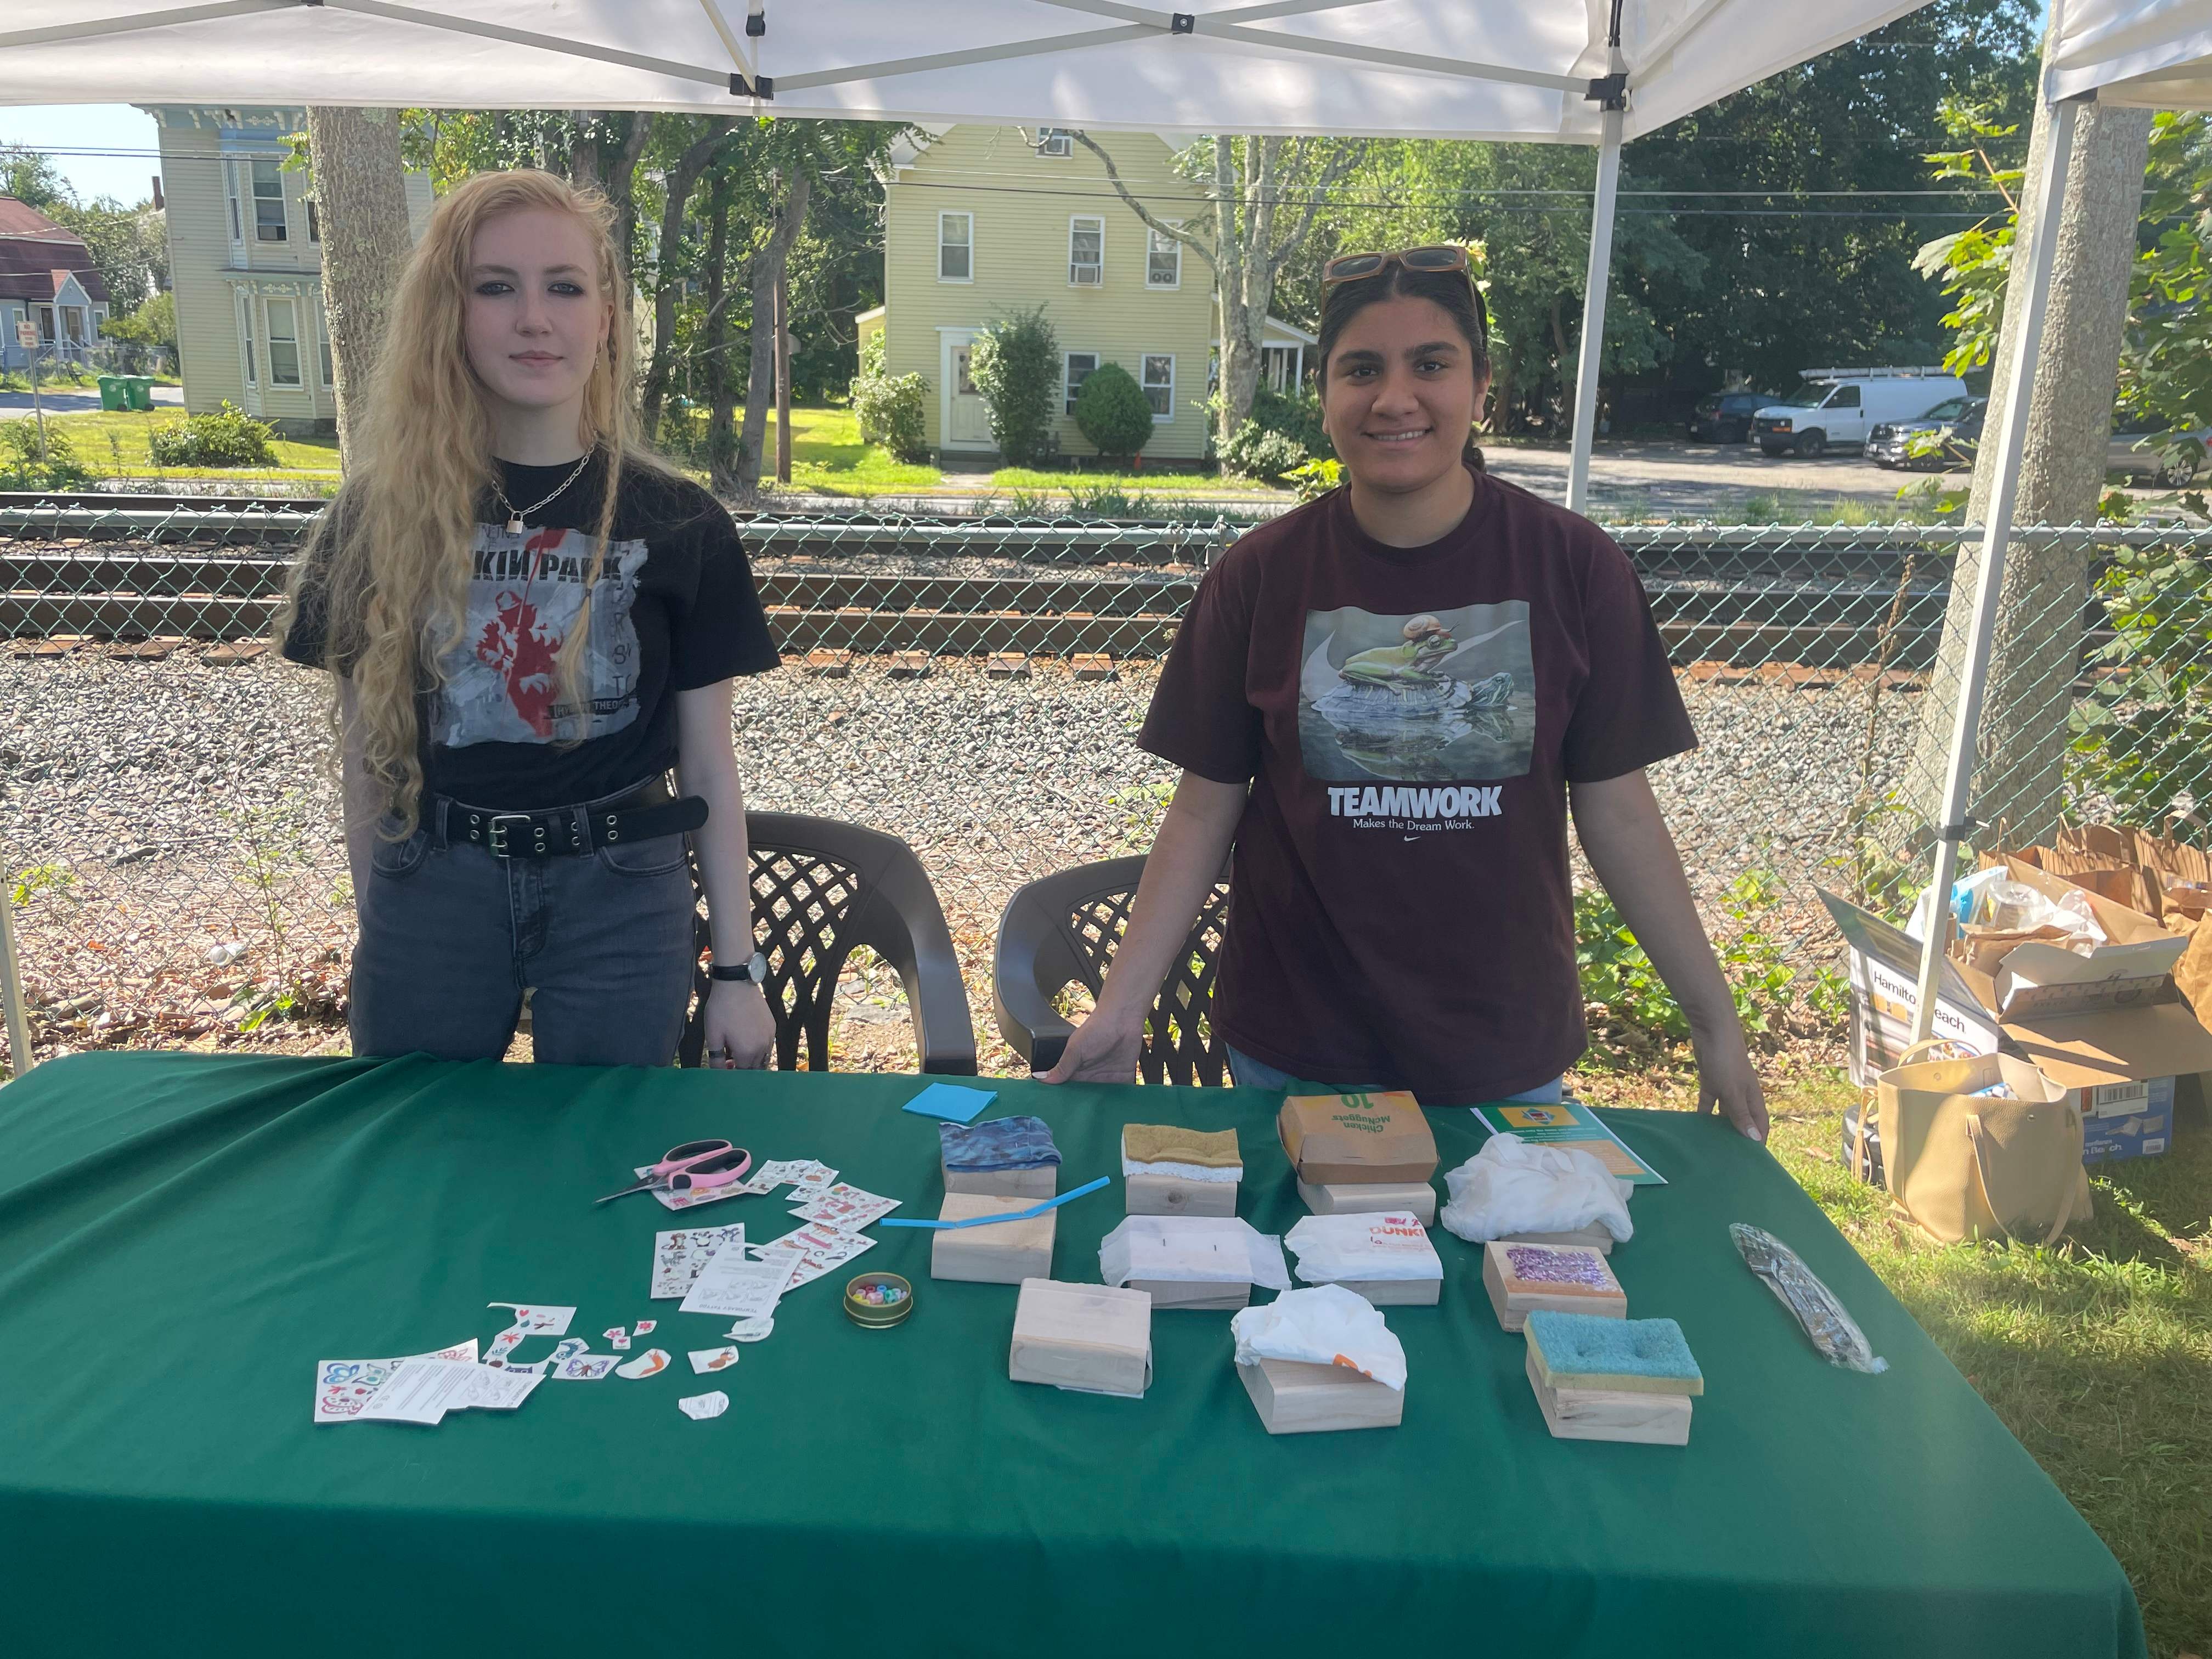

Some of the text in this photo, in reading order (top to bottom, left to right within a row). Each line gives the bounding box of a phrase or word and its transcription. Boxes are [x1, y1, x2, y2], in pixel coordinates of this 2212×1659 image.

[473, 549, 531, 581] KIN
[1328, 785, 1503, 819] TEAMWORK
[1353, 819, 1475, 831] Makes the Dream Work.
[1874, 971, 1966, 1033] Hamilto each
[1341, 1093, 1374, 1109] 10
[1332, 1114, 1390, 1125] McNuggets
[1343, 1122, 1384, 1133] Chicken
[2091, 1143, 2122, 1154] Bech
[1369, 1226, 1424, 1237] DUNKI
